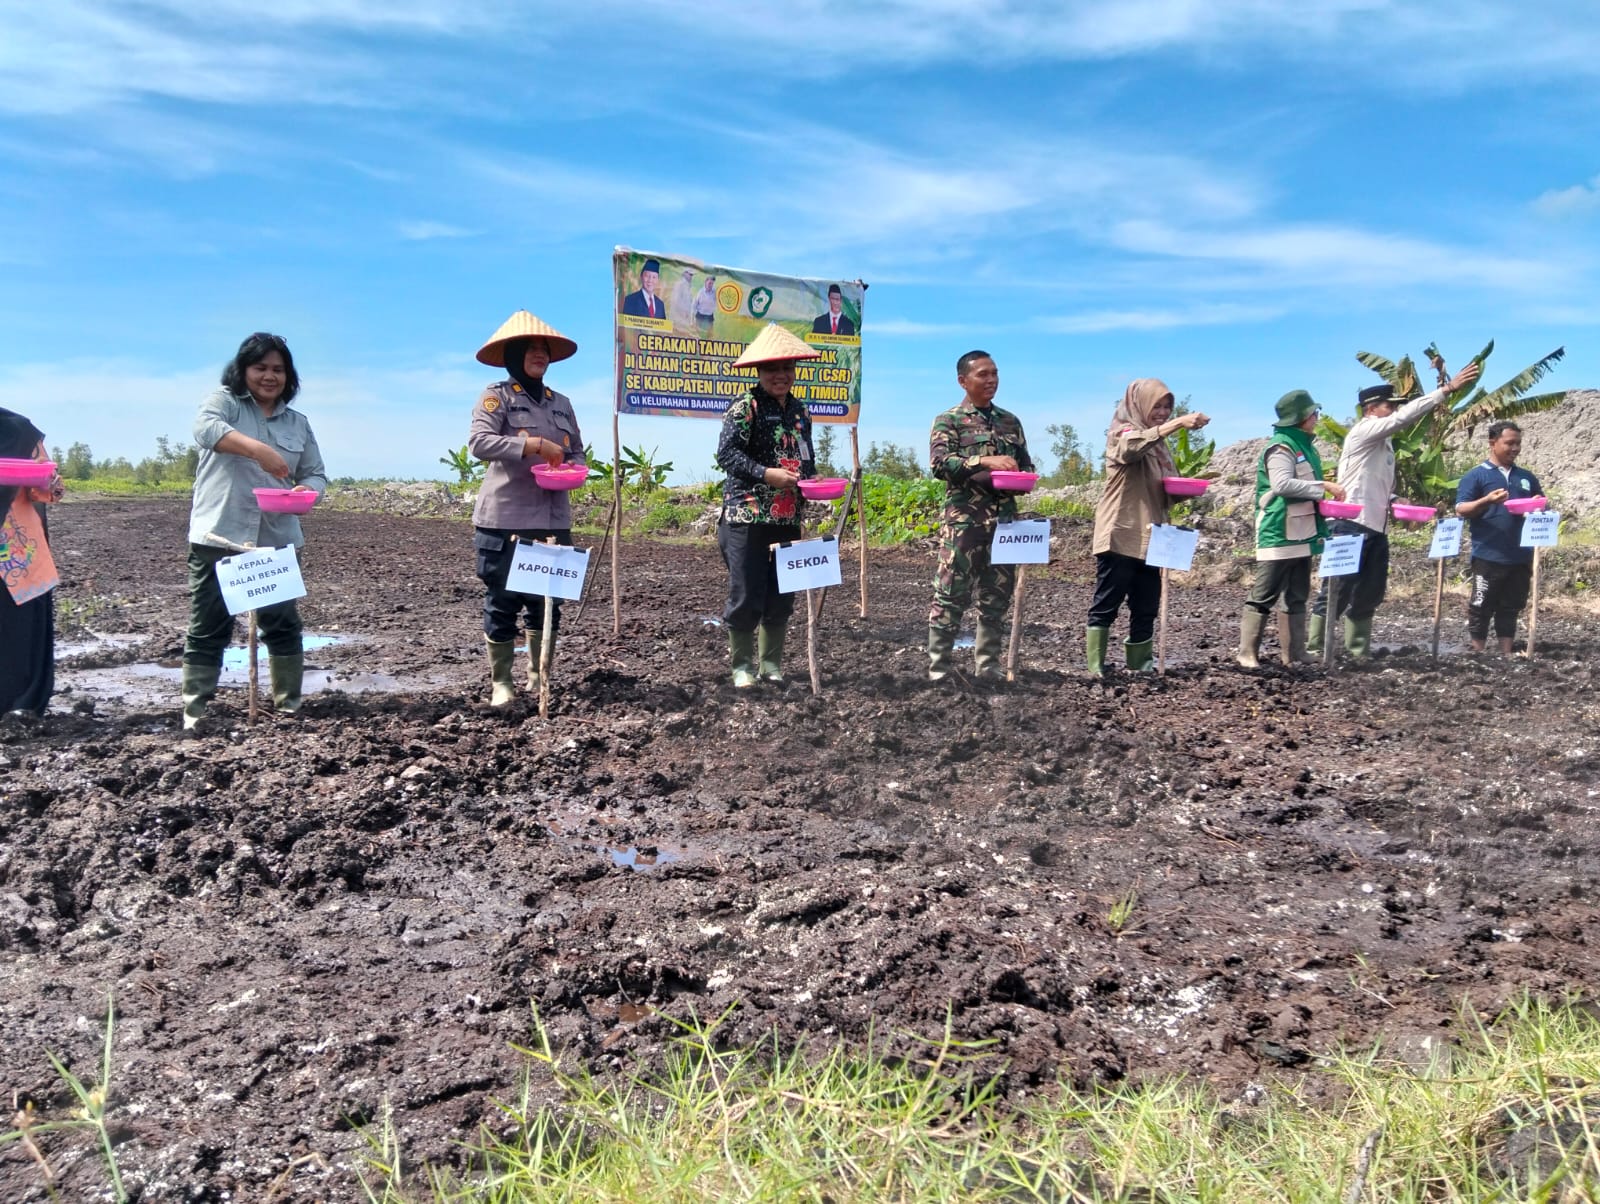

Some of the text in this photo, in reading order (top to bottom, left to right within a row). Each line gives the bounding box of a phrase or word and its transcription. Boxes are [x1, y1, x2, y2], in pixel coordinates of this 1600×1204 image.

[638, 334, 742, 358] GERAKAN TANAM
[624, 353, 851, 384] DI LAHAN CETAK SAWA YAT (CSR)
[625, 373, 641, 390] SE
[643, 375, 713, 395] KABUPATEN
[810, 385, 848, 401] TIMUR
[630, 395, 640, 405] DI
[642, 396, 689, 409] KELURAHAN
[809, 404, 844, 415] AAMANG
[998, 534, 1044, 544] DANDIM
[237, 556, 274, 572] KEPALA
[517, 562, 579, 579] KAPOLRES
[787, 555, 829, 570] SEKDA
[229, 566, 289, 587] BALAI BESAR
[246, 583, 278, 598] BRMP
